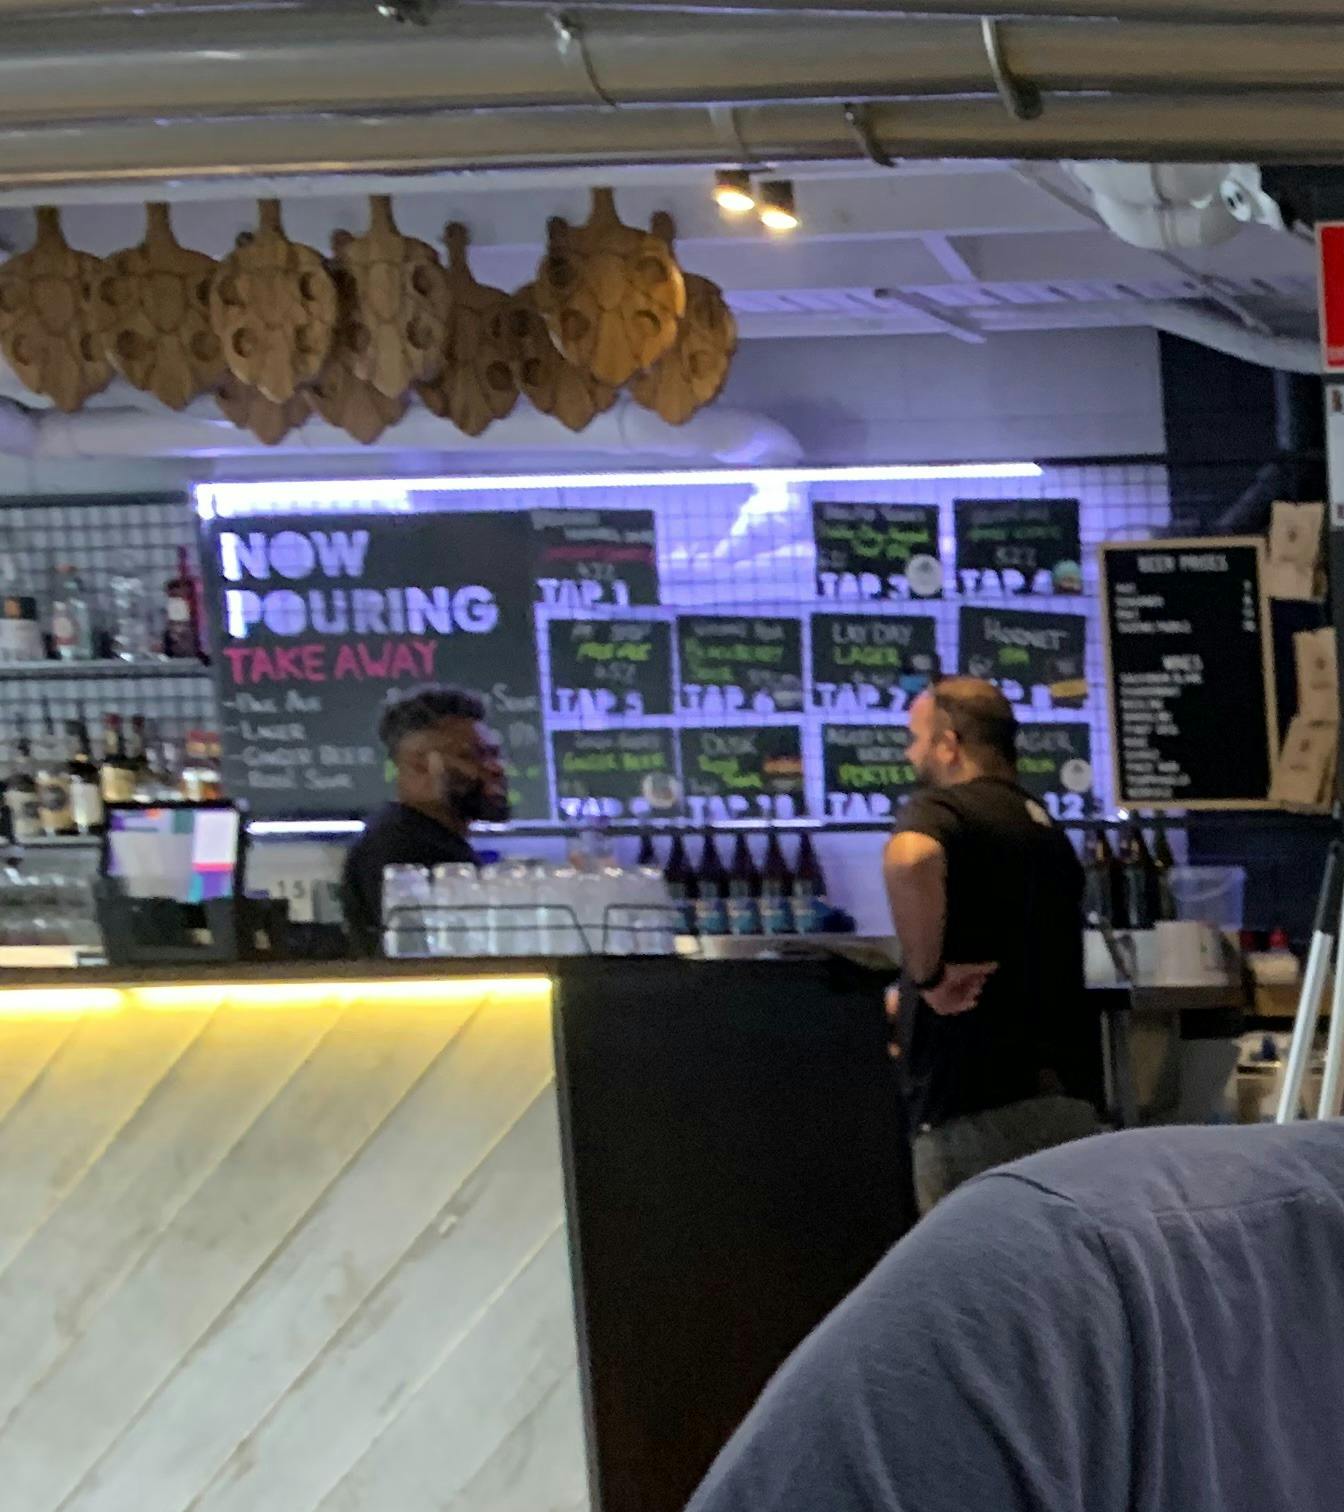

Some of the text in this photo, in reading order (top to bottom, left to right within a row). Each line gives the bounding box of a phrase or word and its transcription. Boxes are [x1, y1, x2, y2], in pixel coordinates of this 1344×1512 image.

[219, 529, 369, 580] NOW
[535, 578, 604, 607] TAP
[819, 571, 882, 600] TAP
[959, 568, 1026, 597] TAP
[224, 583, 500, 639] POURING
[223, 640, 439, 684] TAKE AWAY
[555, 687, 618, 713] TAP
[682, 684, 745, 711] TAP
[815, 682, 881, 709] TAP
[687, 795, 750, 823] TAP
[828, 793, 892, 819] TAP
[1043, 791, 1086, 820] 12
